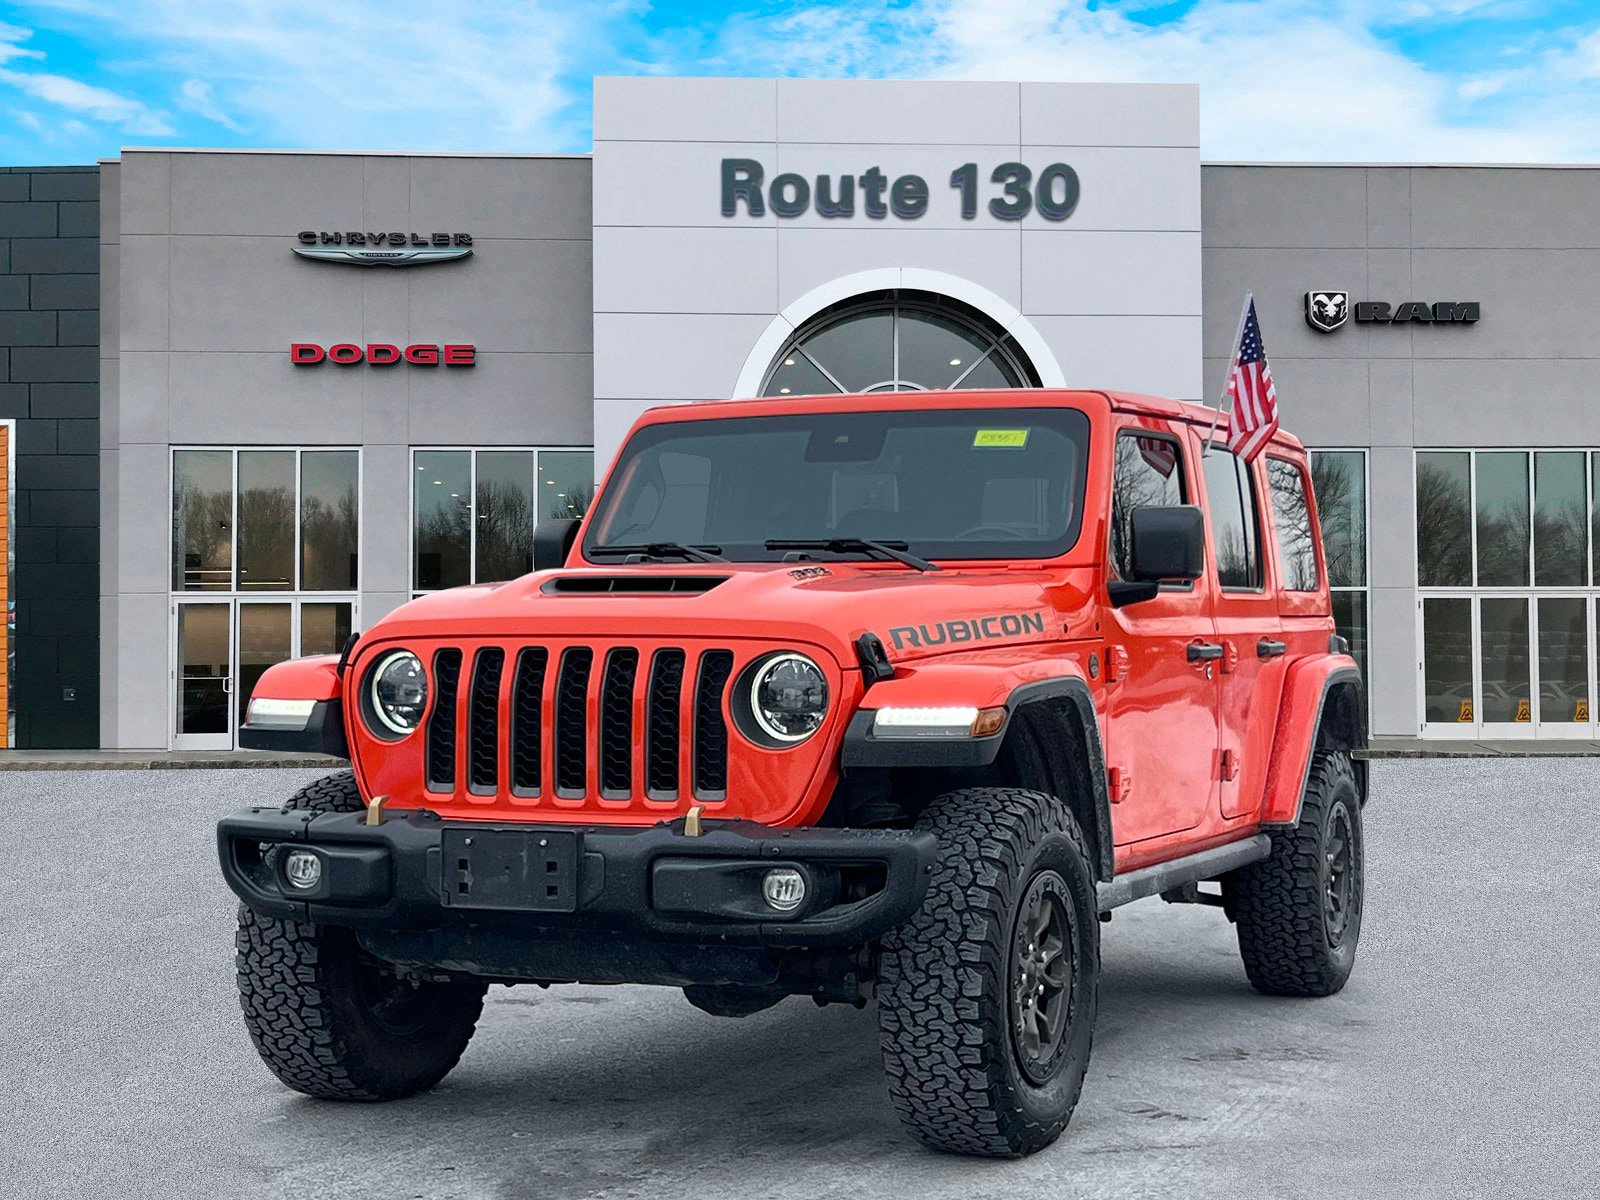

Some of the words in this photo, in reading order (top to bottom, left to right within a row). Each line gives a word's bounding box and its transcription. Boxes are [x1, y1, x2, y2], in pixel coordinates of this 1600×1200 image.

[721, 158, 929, 218] Route
[950, 162, 1080, 220] 130
[298, 231, 473, 245] CHRYSLER
[1355, 302, 1480, 324] RAM
[291, 343, 475, 365] DODGE
[889, 611, 1044, 650] RUBICON
